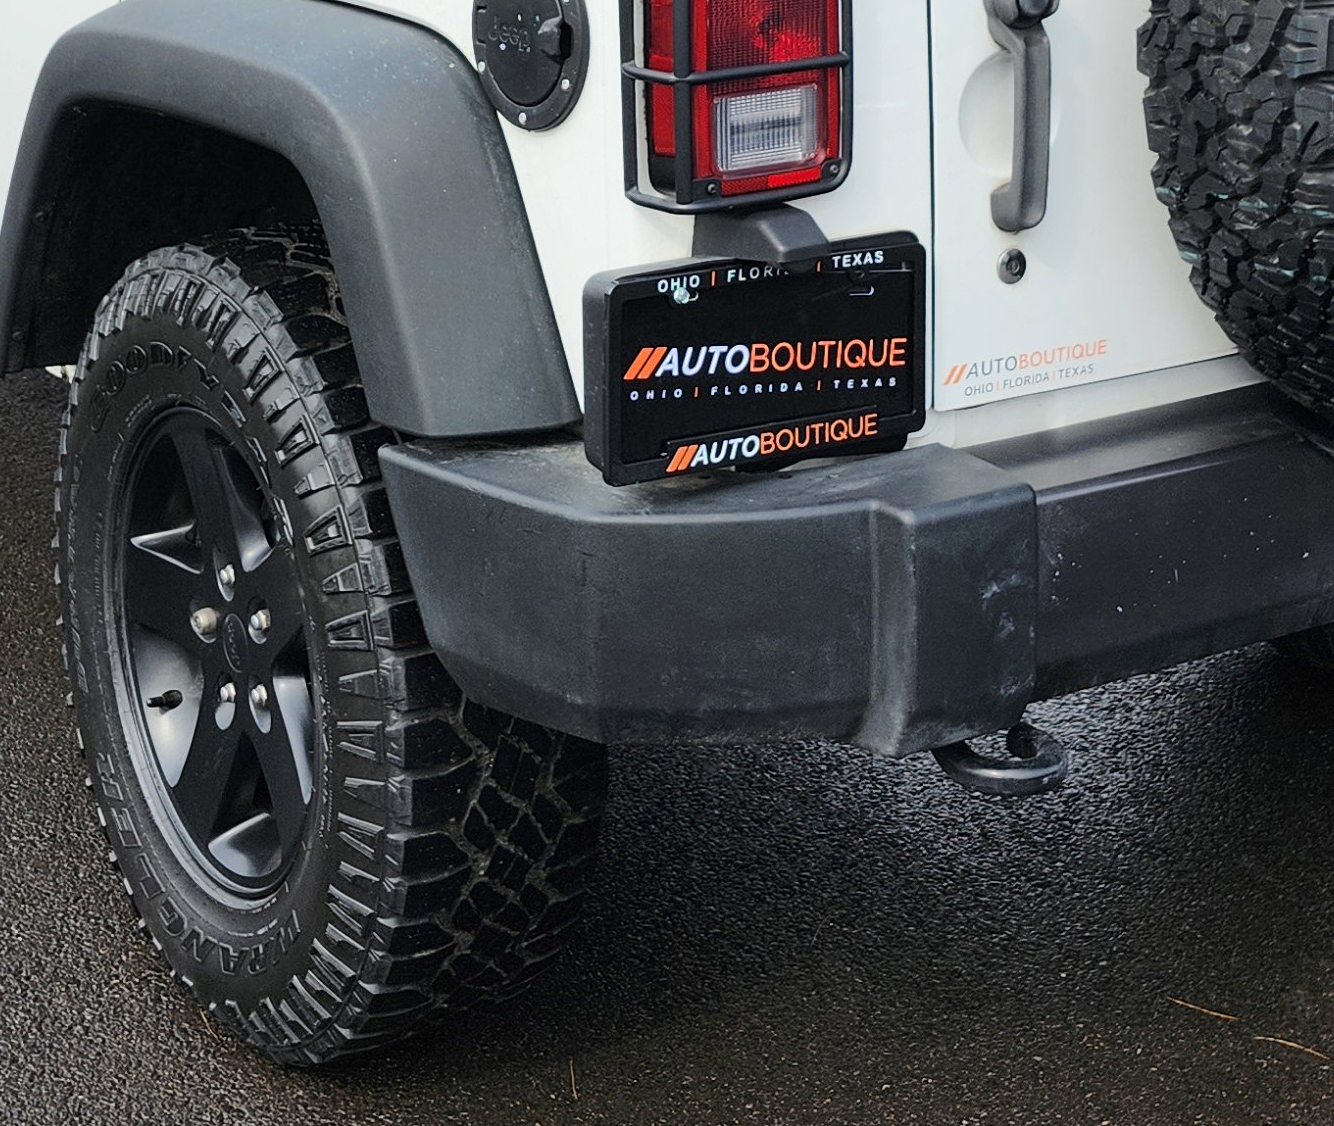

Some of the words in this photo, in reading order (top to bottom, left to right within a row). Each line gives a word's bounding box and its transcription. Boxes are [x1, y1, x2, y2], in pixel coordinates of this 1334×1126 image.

[657, 275, 701, 293] OHIO
[832, 250, 885, 269] TEXAS
[655, 338, 908, 377] AUTOBOUTIQUE
[965, 339, 1108, 380] AUTOBOUTIQUE
[630, 388, 683, 401] OHIO
[710, 381, 804, 396] FLORIDA
[833, 376, 898, 390] TEXAS
[964, 382, 994, 397] OHIO
[1002, 372, 1050, 390] FLORIDA
[1058, 363, 1095, 379] TEXAS
[690, 413, 879, 468] AUTOBOUTIQUE
